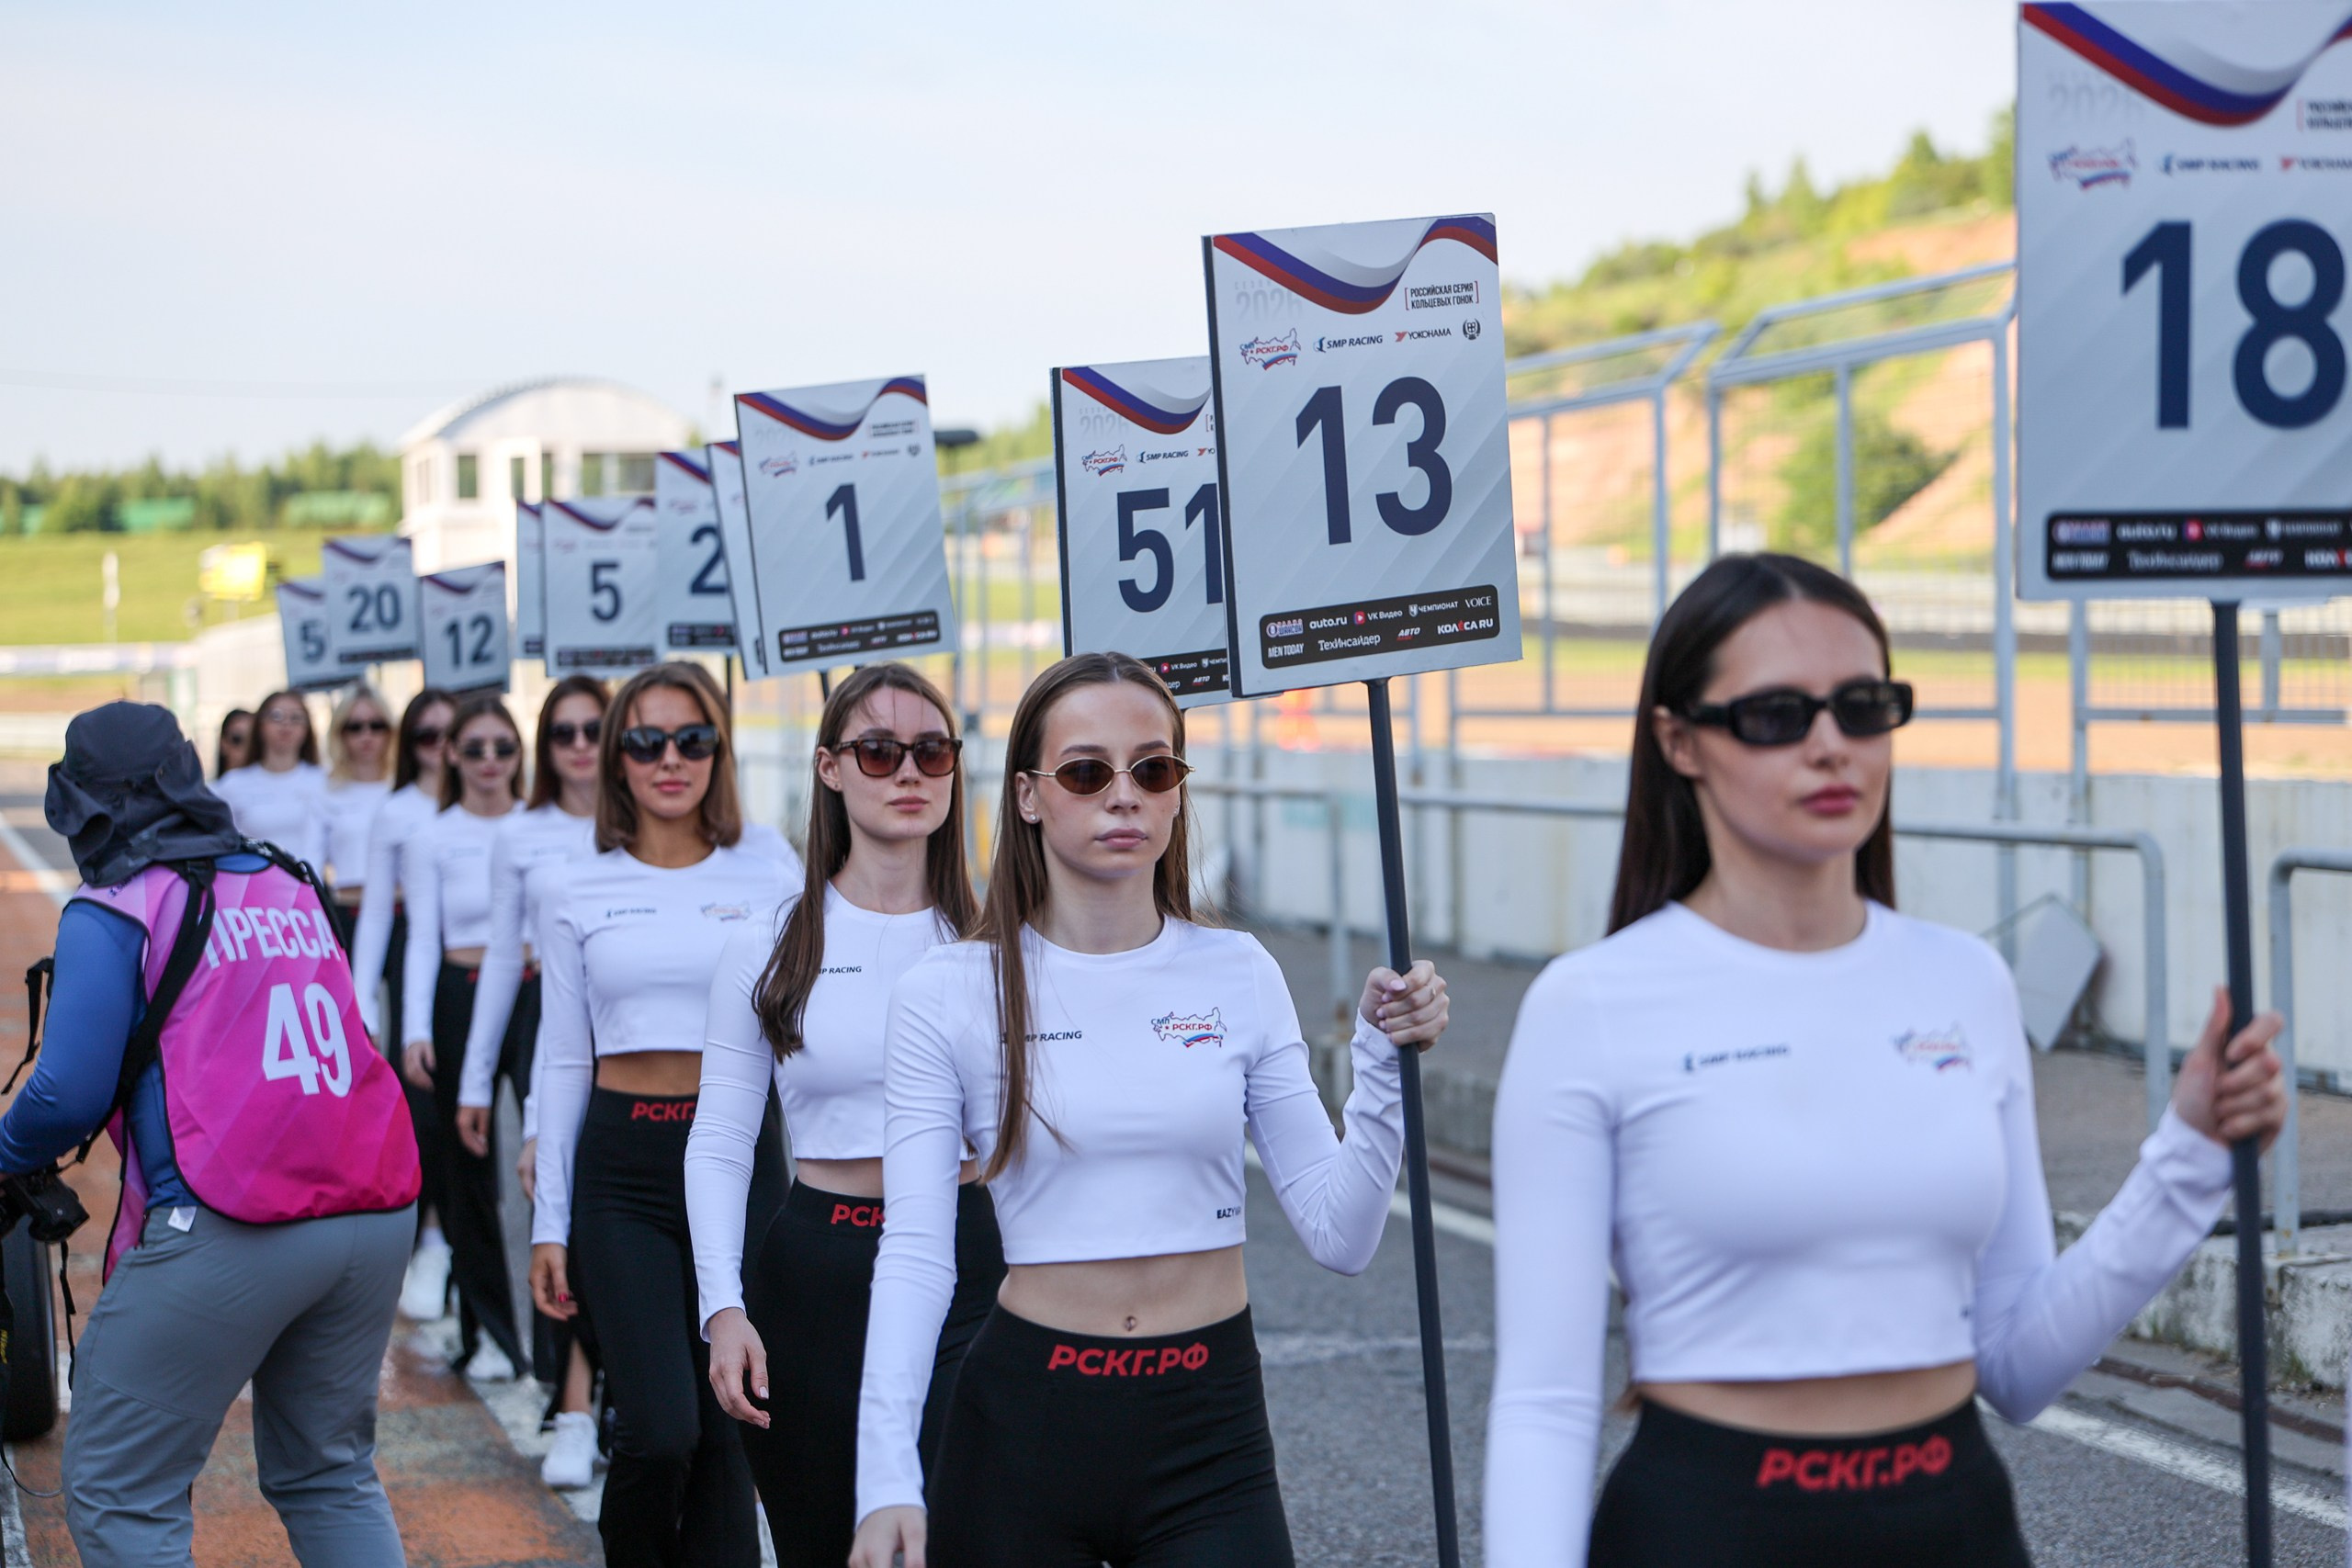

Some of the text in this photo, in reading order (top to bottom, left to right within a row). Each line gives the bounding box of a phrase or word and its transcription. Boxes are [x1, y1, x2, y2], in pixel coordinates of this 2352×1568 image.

[1410, 282, 1474, 298] РОССИЙСКАЯ СЕРИЯ
[1411, 294, 1474, 310] КОЛЬЦЕВЫХ ГОНОК
[2121, 218, 2347, 430] 18
[1327, 334, 1383, 349] SMP RACING
[1408, 328, 1452, 340] YOKOHAMA
[1146, 450, 1189, 461] SMP RACING
[1295, 376, 1453, 546] 13
[825, 482, 865, 582] 1
[1116, 482, 1224, 613] 51
[591, 561, 622, 622] 5
[346, 583, 402, 633] 20
[1419, 601, 1459, 613] ЧЕМПИОНАТ
[1464, 595, 1492, 608] VOICE
[1309, 616, 1348, 629] auto.ru
[1367, 610, 1403, 621] VK Видео
[1397, 627, 1420, 637] АВТО
[300, 620, 326, 663] 5
[443, 614, 495, 667] 12
[1317, 634, 1381, 651] ТехИнсайдер
[1268, 643, 1305, 659] MEN TODAY
[829, 965, 862, 975] RACING
[262, 982, 353, 1098] 49
[1039, 1030, 1082, 1042] RACING
[1047, 1342, 1209, 1376] РСКГ.РФ
[1756, 1434, 1953, 1491] РСКГ.РФ
